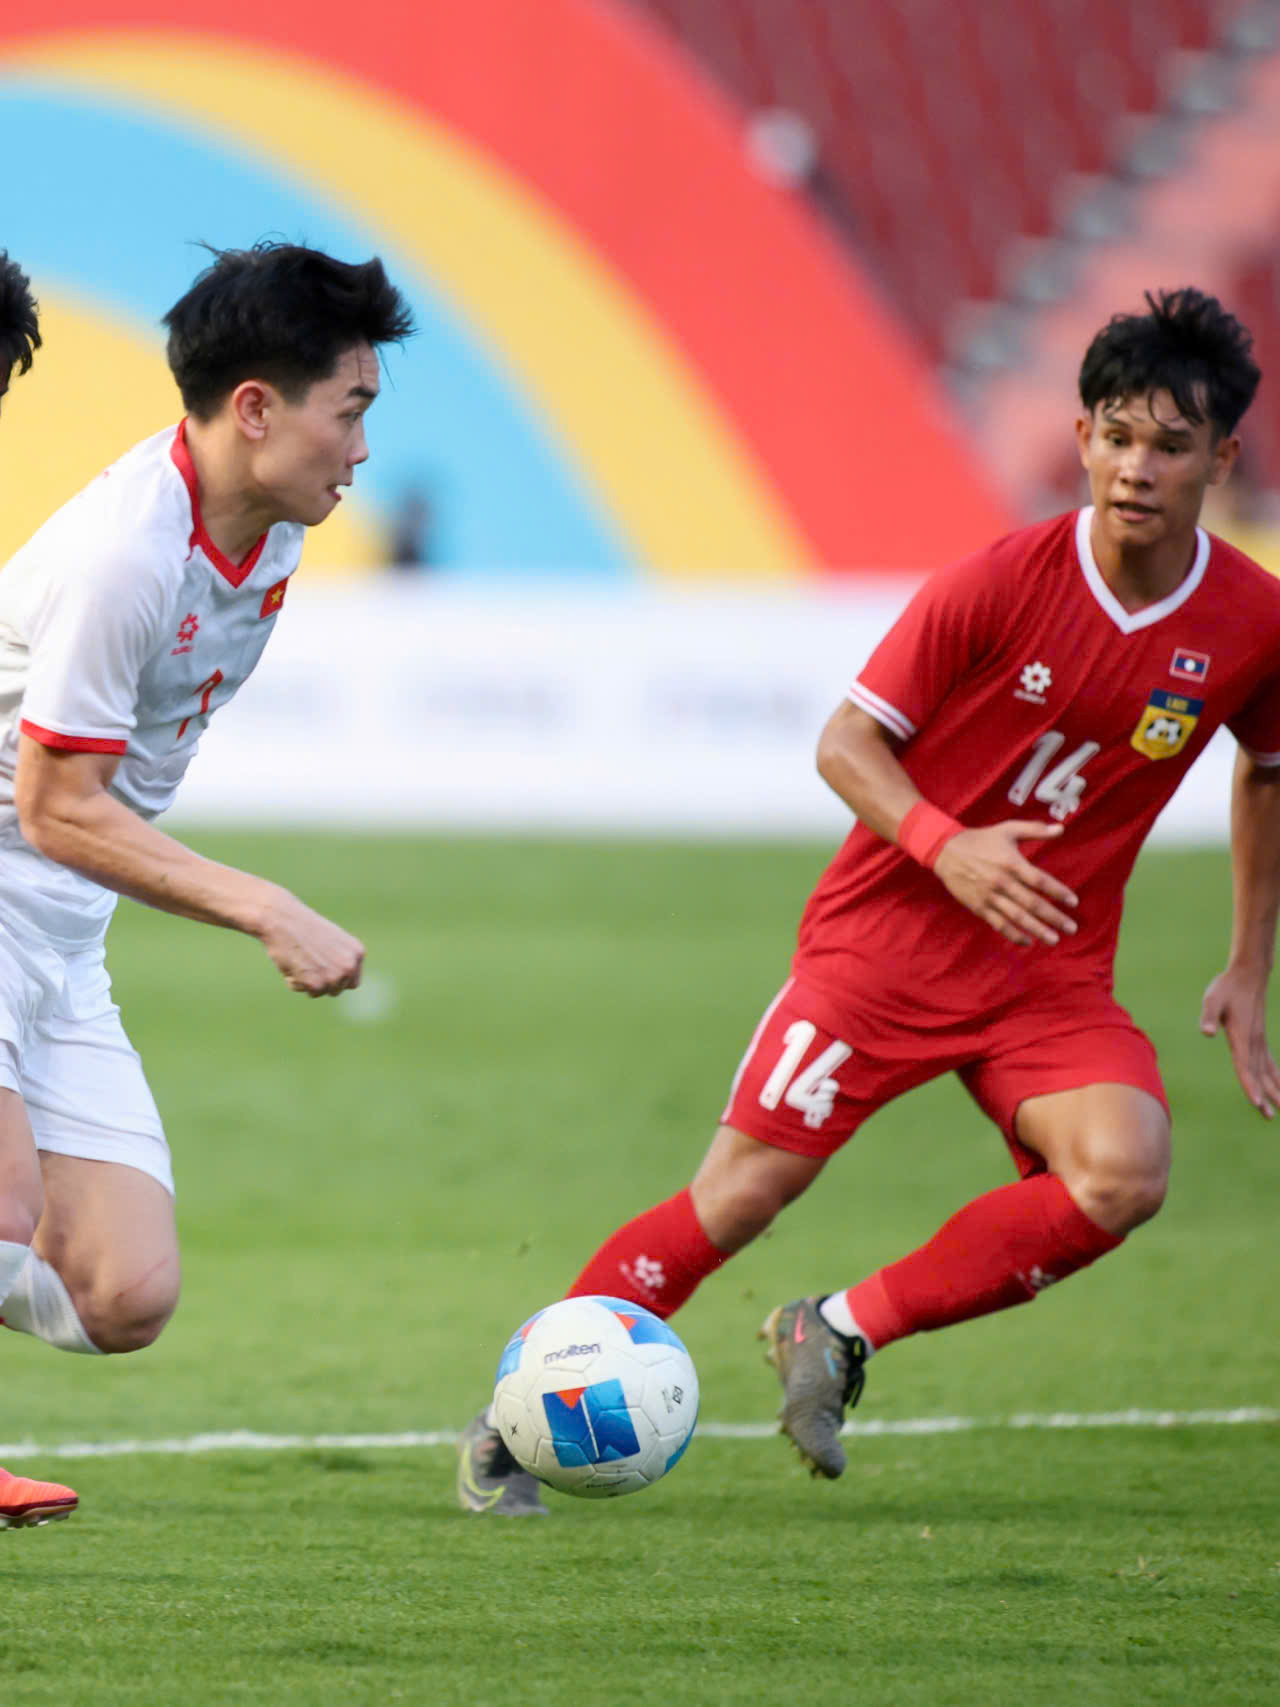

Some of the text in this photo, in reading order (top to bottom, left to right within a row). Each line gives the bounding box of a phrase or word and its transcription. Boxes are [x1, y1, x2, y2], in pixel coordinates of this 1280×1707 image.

[1008, 731, 1100, 821] 14
[759, 1019, 853, 1129] 14
[543, 1343, 601, 1364] molten
